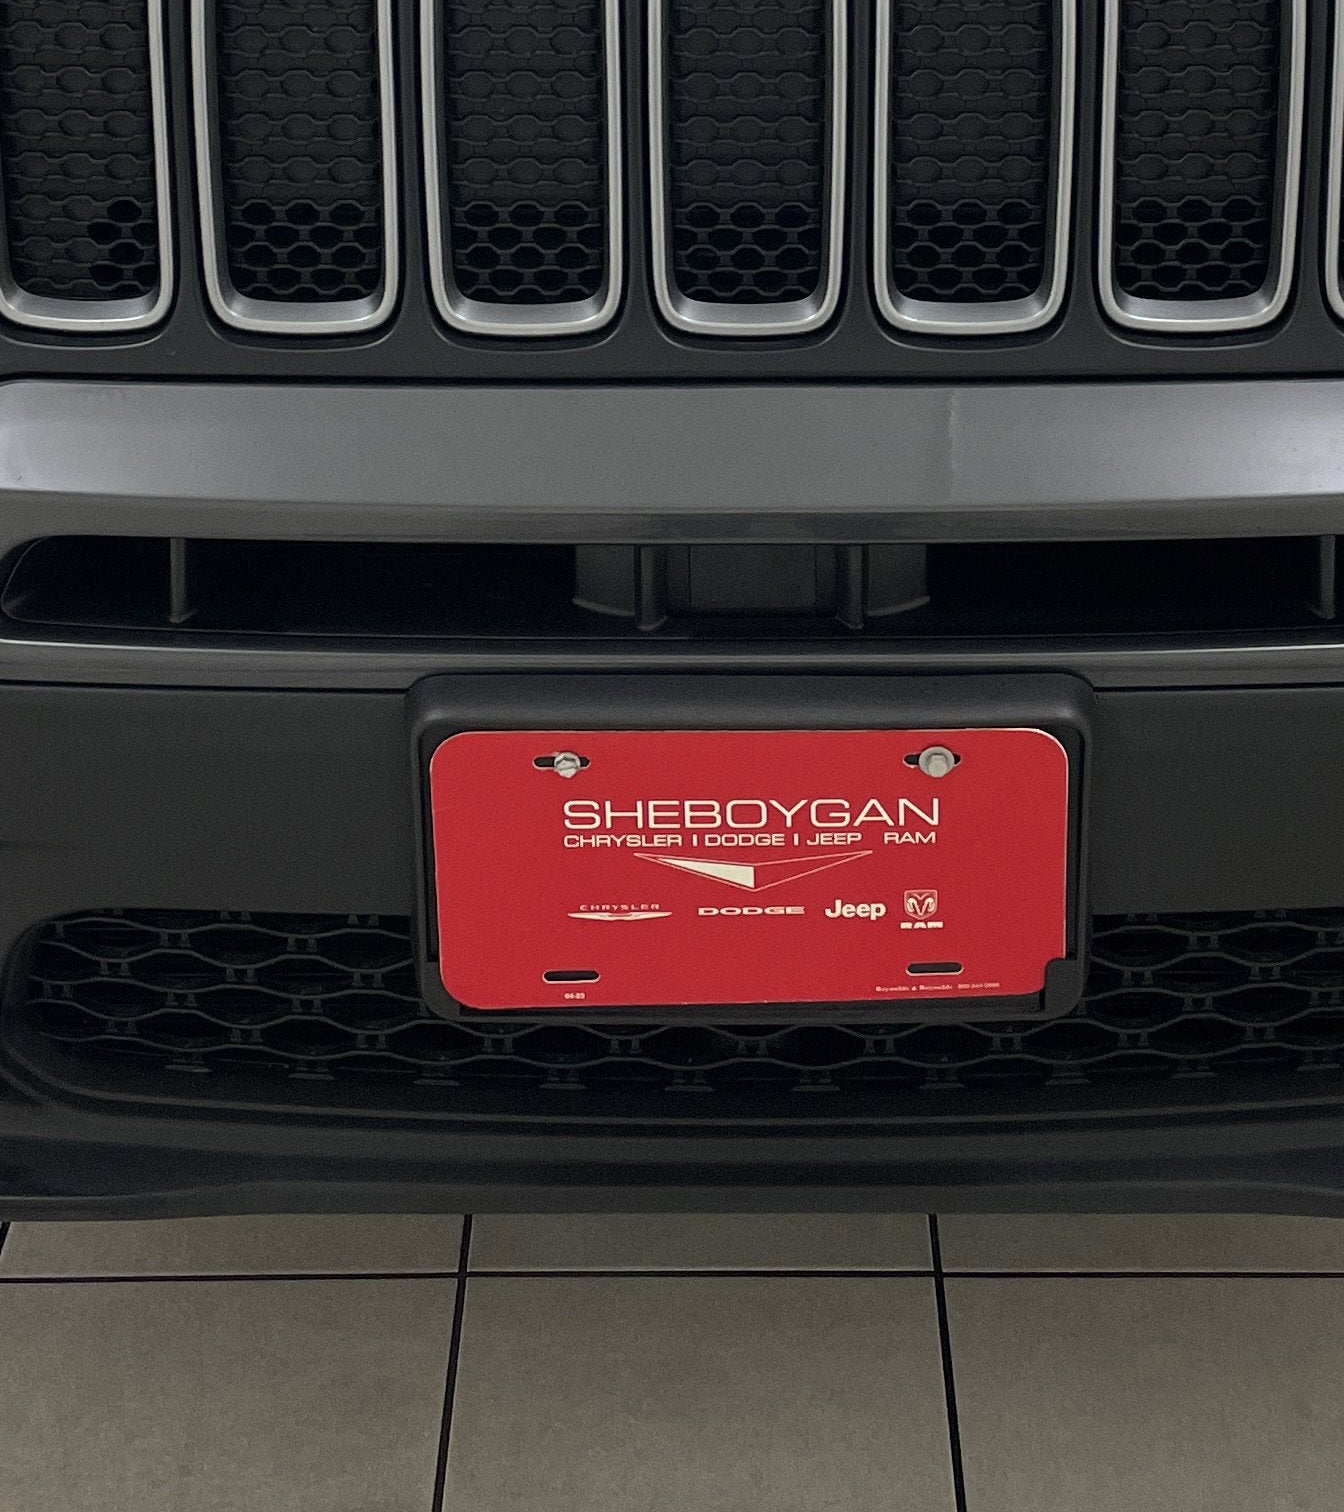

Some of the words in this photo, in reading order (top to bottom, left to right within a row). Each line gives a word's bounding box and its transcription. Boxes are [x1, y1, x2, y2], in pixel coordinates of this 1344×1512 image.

[563, 797, 940, 830] SHEBOYGAN
[563, 833, 682, 849] CHRYSLER
[705, 833, 785, 847] DODGE
[807, 832, 862, 846] JEEP
[884, 831, 936, 845] RAM
[579, 903, 661, 911] CHRYSLER
[698, 906, 805, 916] DODGE
[824, 899, 887, 921] Jeep
[900, 921, 944, 929] RAM
